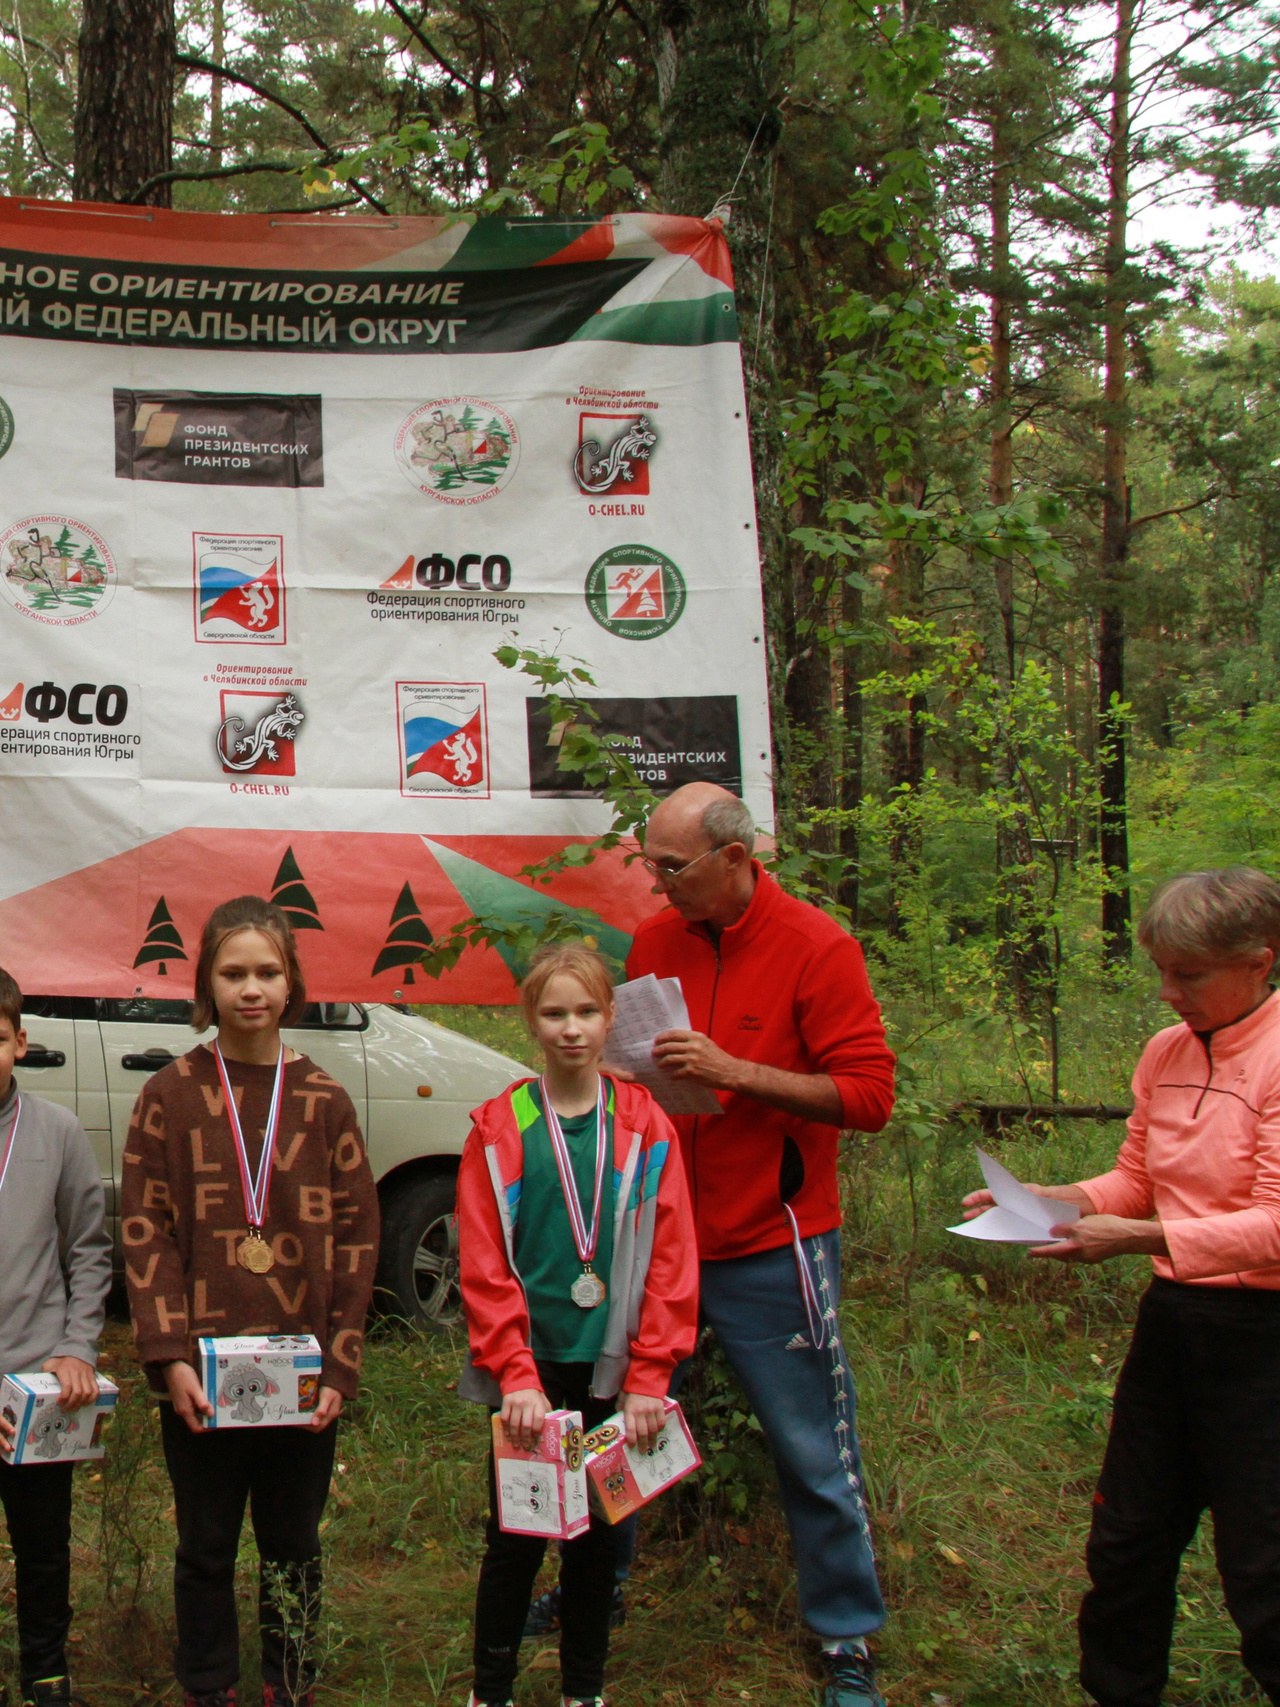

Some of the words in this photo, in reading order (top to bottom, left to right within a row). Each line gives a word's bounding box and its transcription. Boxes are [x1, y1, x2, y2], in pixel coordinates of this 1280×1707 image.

[90, 273, 464, 305] ОРИЕНТИРОВАНИЕ
[42, 302, 336, 343] ФЕДЕРАЛЬНЫЙ
[348, 317, 466, 345] ОКРУГ
[579, 385, 646, 399] Ориентирование
[572, 396, 621, 409] Челябинской
[623, 399, 659, 409] области
[184, 424, 228, 437] ФОНД
[184, 439, 309, 455] ПРЕЗИДЕНТСКИХ
[184, 455, 251, 468] ГРАНТОВ
[588, 504, 645, 516] O-CHEL.RU
[11, 515, 67, 532] СПОРТИВНОГО
[67, 519, 115, 574] ОРИЕНТИРОВАНИЯ
[415, 552, 512, 592] ФСО
[366, 591, 441, 608] Федерация
[443, 595, 526, 610] спортивного
[14, 601, 62, 626] КУРГАНСКОЙ
[63, 610, 98, 626] ОБЛАСТИ
[370, 608, 479, 623] ориентирования
[482, 609, 519, 626] Югры
[216, 663, 294, 676] Ориентирование
[203, 674, 208, 682] в
[210, 674, 267, 685] Челябинской
[268, 676, 308, 686] области
[24, 681, 129, 726] ФСО
[53, 730, 141, 745] спортивного
[94, 744, 134, 762] Югры
[600, 752, 727, 765] ЗИДЕНТСКИХ
[229, 782, 290, 796] O-CHEL.RU
